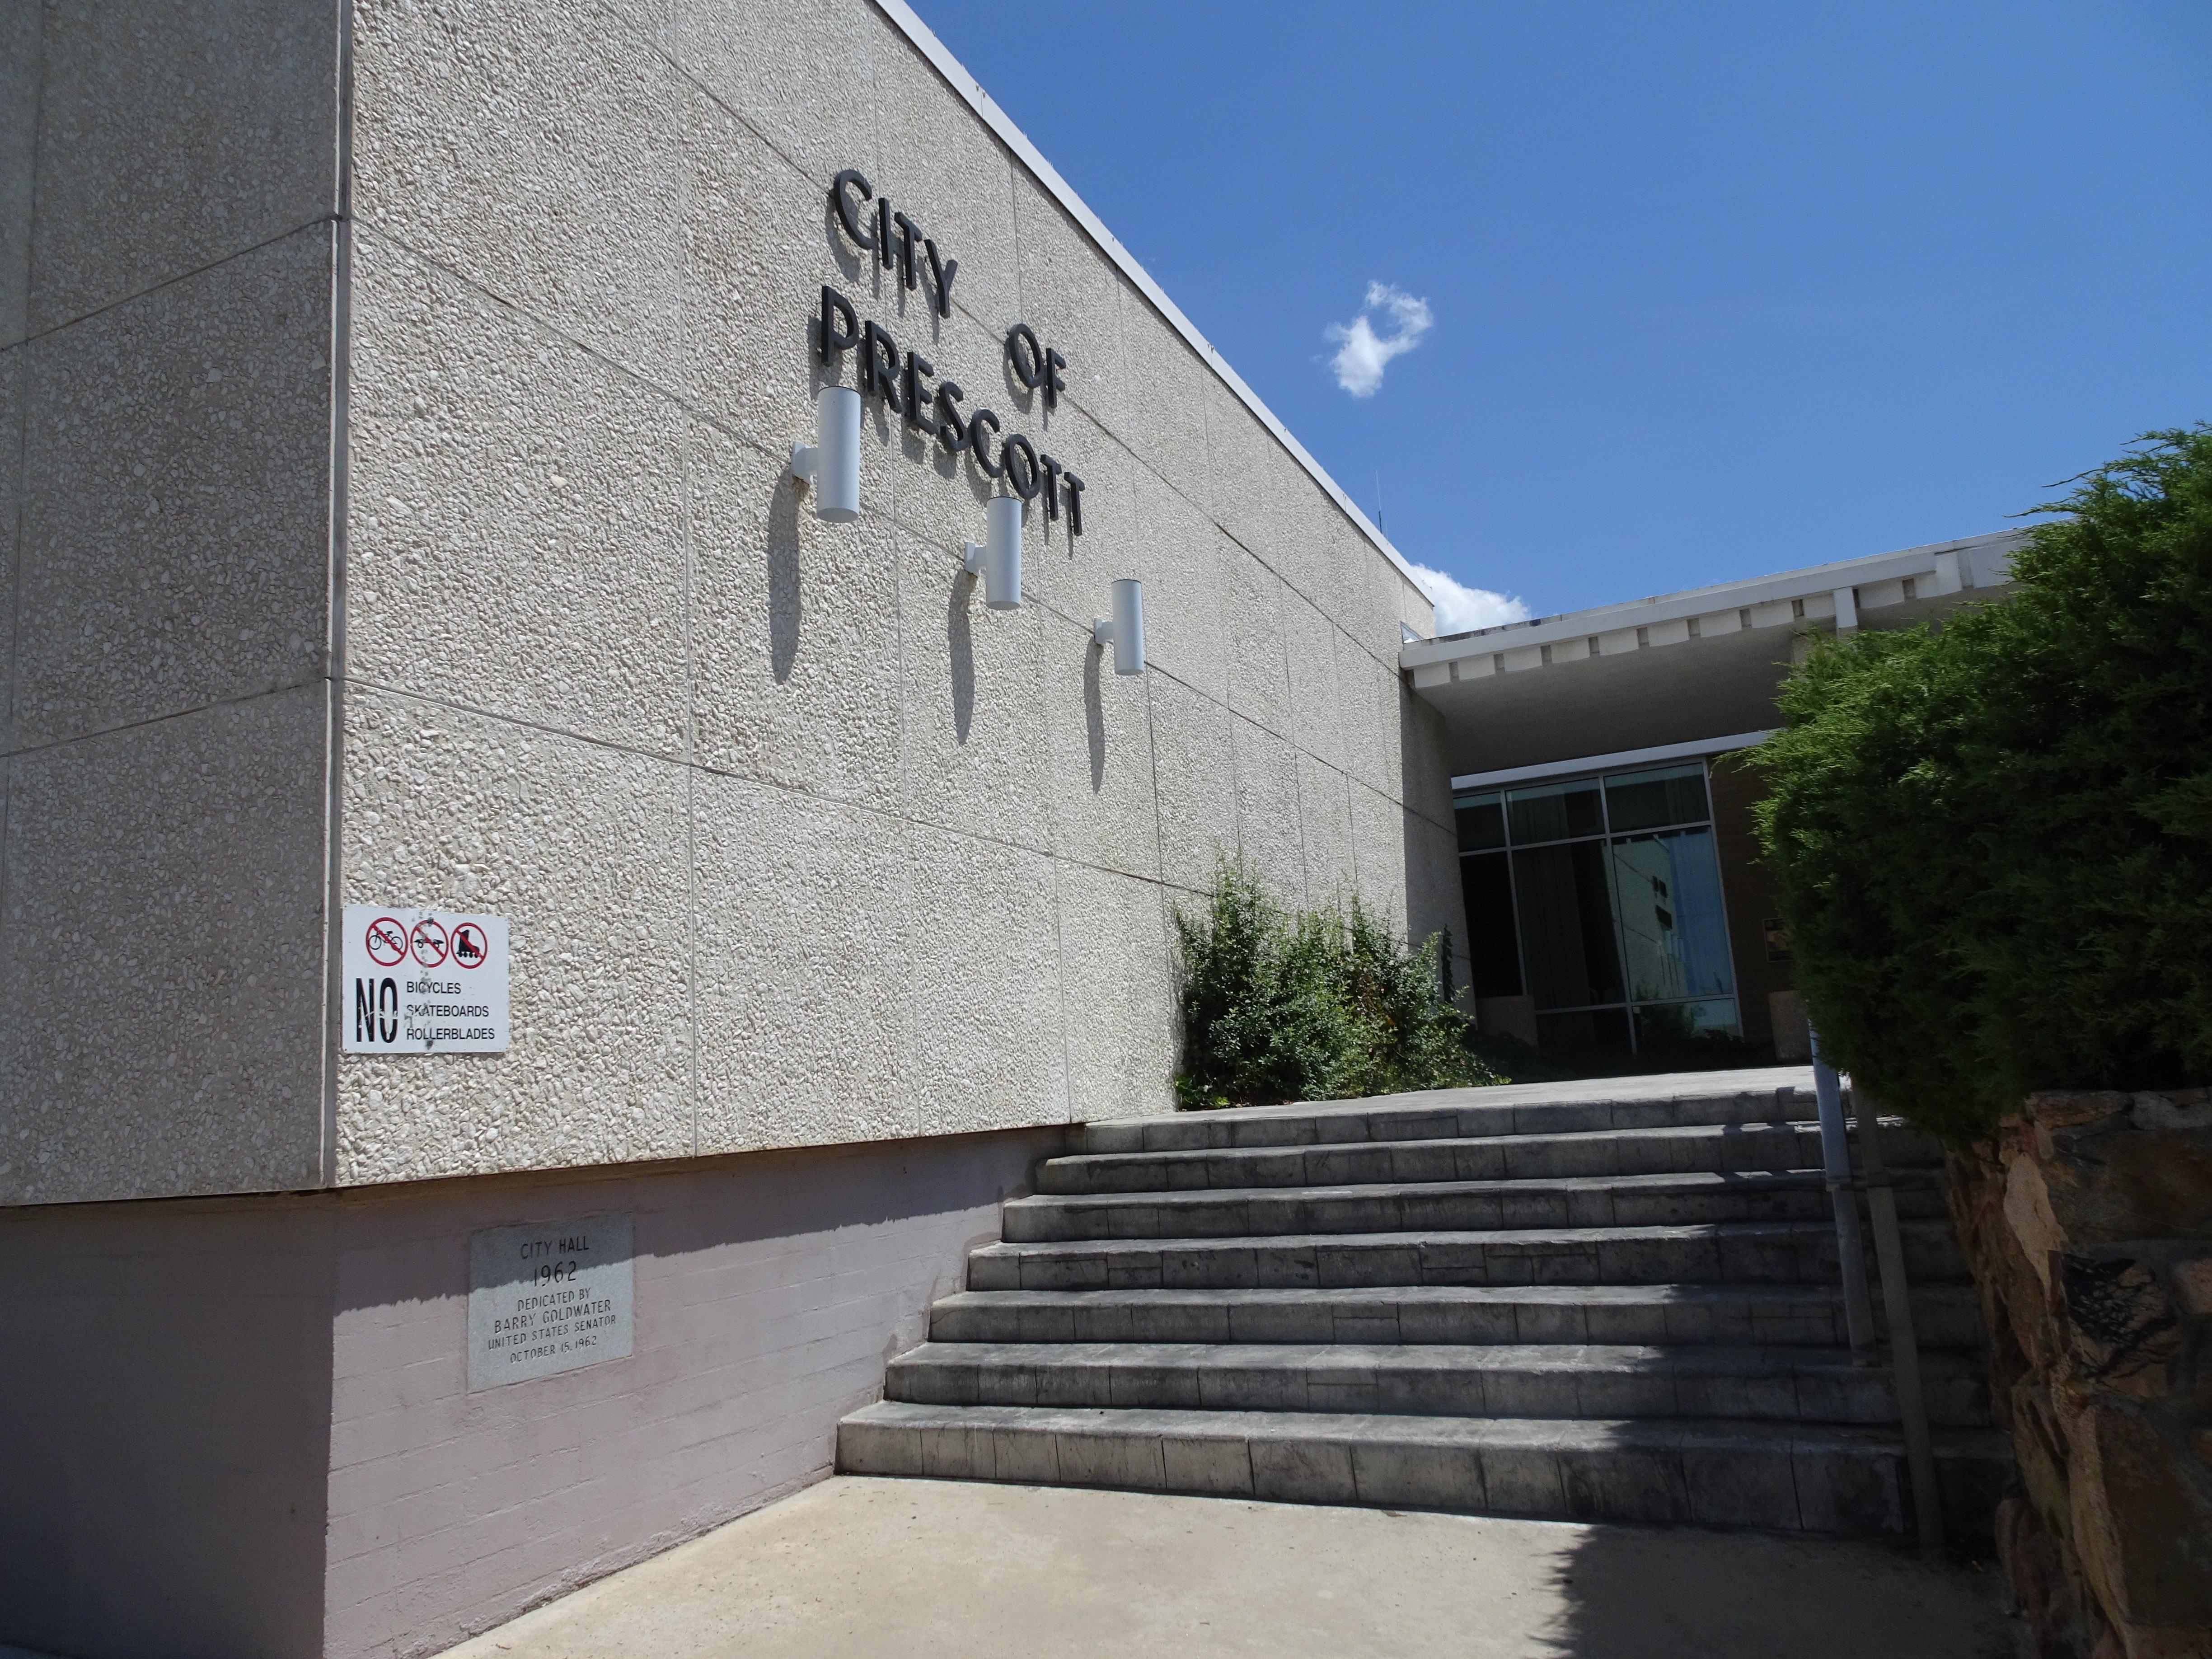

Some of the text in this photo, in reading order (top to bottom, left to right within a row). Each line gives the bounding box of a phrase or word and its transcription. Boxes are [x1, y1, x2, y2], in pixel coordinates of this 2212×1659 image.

[833, 169, 1067, 408] CITY OF
[821, 286, 1085, 536] PRESCOTT
[407, 981, 461, 994] BICYCLES
[356, 977, 398, 1043] NO
[407, 1004, 489, 1017] SKATEBOARDS
[407, 1028, 495, 1040] ROLLERBLADES
[520, 1236, 590, 1259] CITY HALL
[534, 1261, 577, 1287] 1962
[518, 1288, 591, 1311] DEDICATED BY
[495, 1299, 611, 1333] BARRY GOLDWATER
[488, 1315, 616, 1350] UNITED STATES SENATOR
[510, 1345, 555, 1363] OCTOBER
[576, 1336, 597, 1349] 1962
